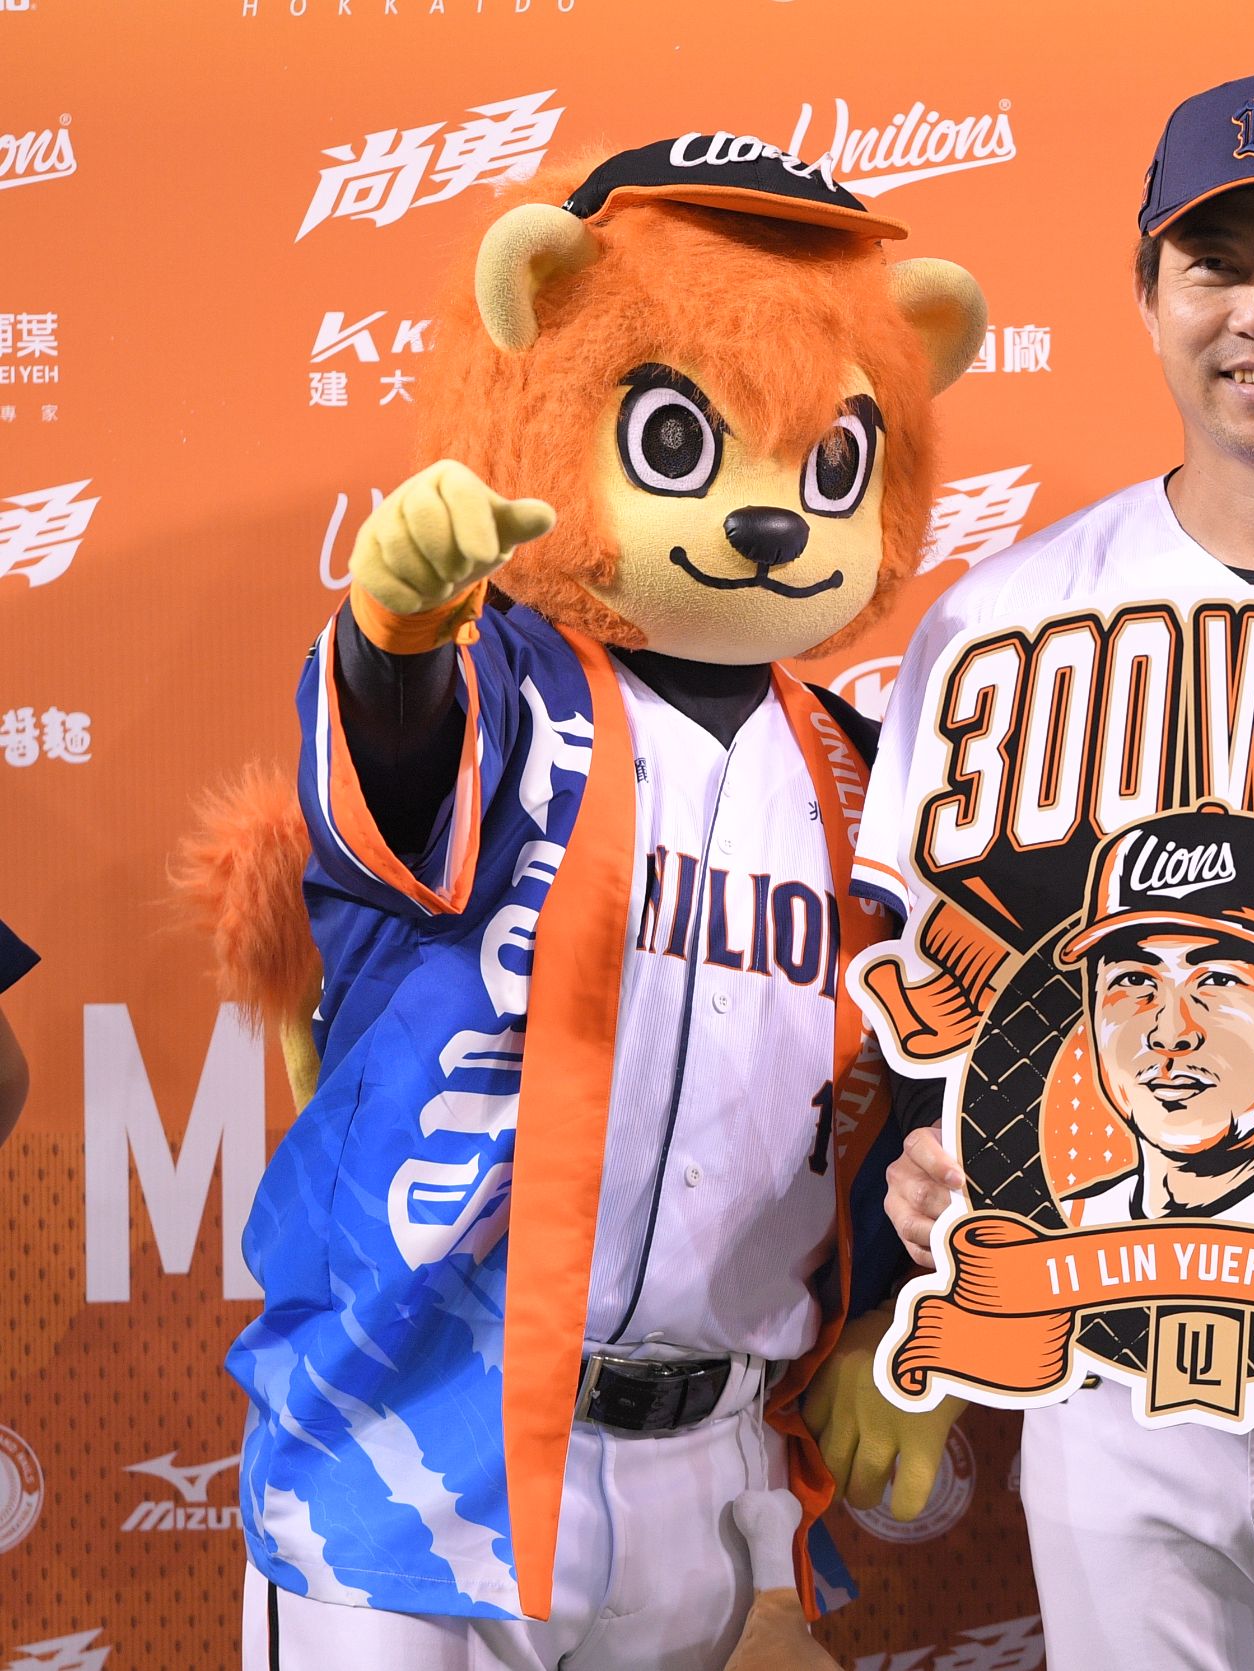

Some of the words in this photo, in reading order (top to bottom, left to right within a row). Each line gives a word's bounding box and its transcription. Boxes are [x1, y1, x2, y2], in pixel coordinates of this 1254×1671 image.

[294, 89, 566, 244] 尚勇
[19, 365, 59, 384] YEH
[308, 369, 416, 406] 建大
[924, 608, 1178, 872] 300
[1130, 841, 1237, 898] Lions
[1046, 1255, 1080, 1295] 11
[1097, 1243, 1156, 1287] LIN
